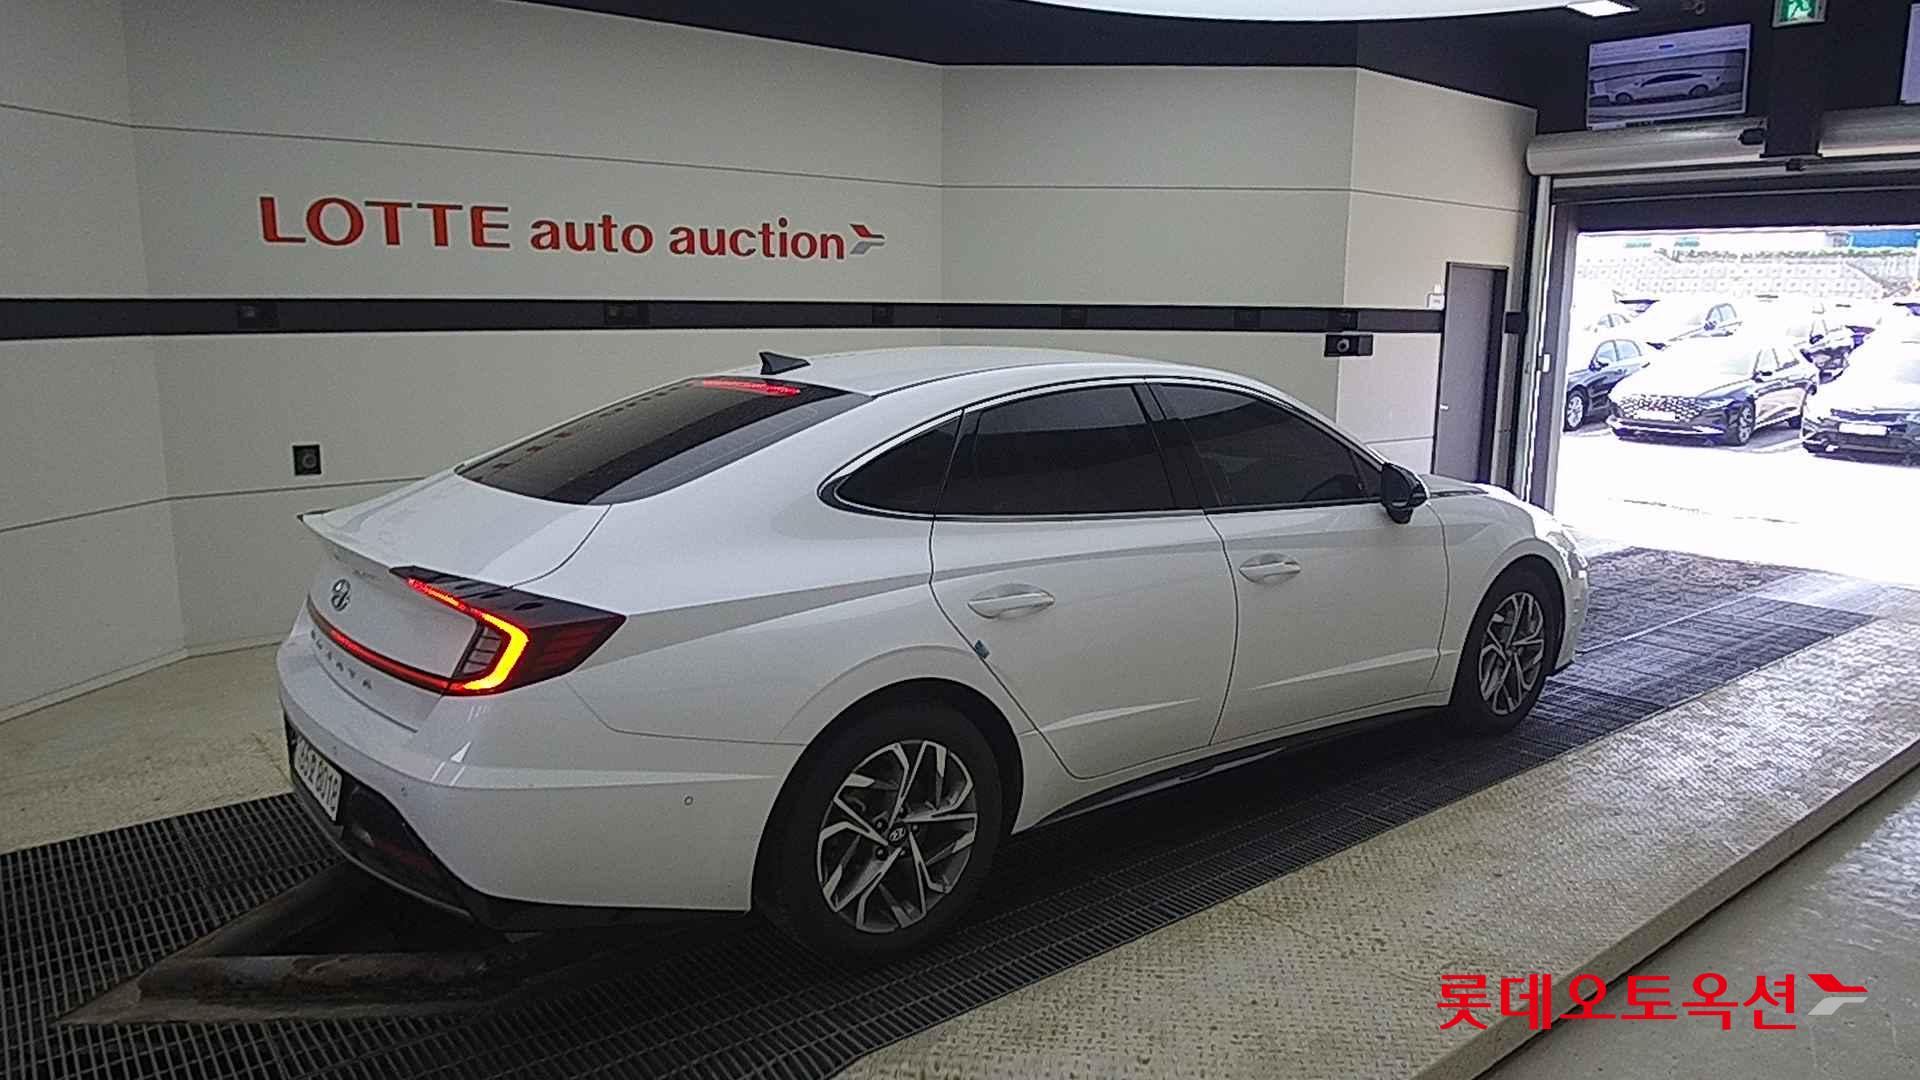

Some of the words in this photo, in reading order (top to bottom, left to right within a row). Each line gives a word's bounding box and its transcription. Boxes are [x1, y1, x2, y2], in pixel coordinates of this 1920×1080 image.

[259, 196, 510, 249] LOTTE
[530, 214, 654, 253] auto
[669, 218, 846, 260] auction
